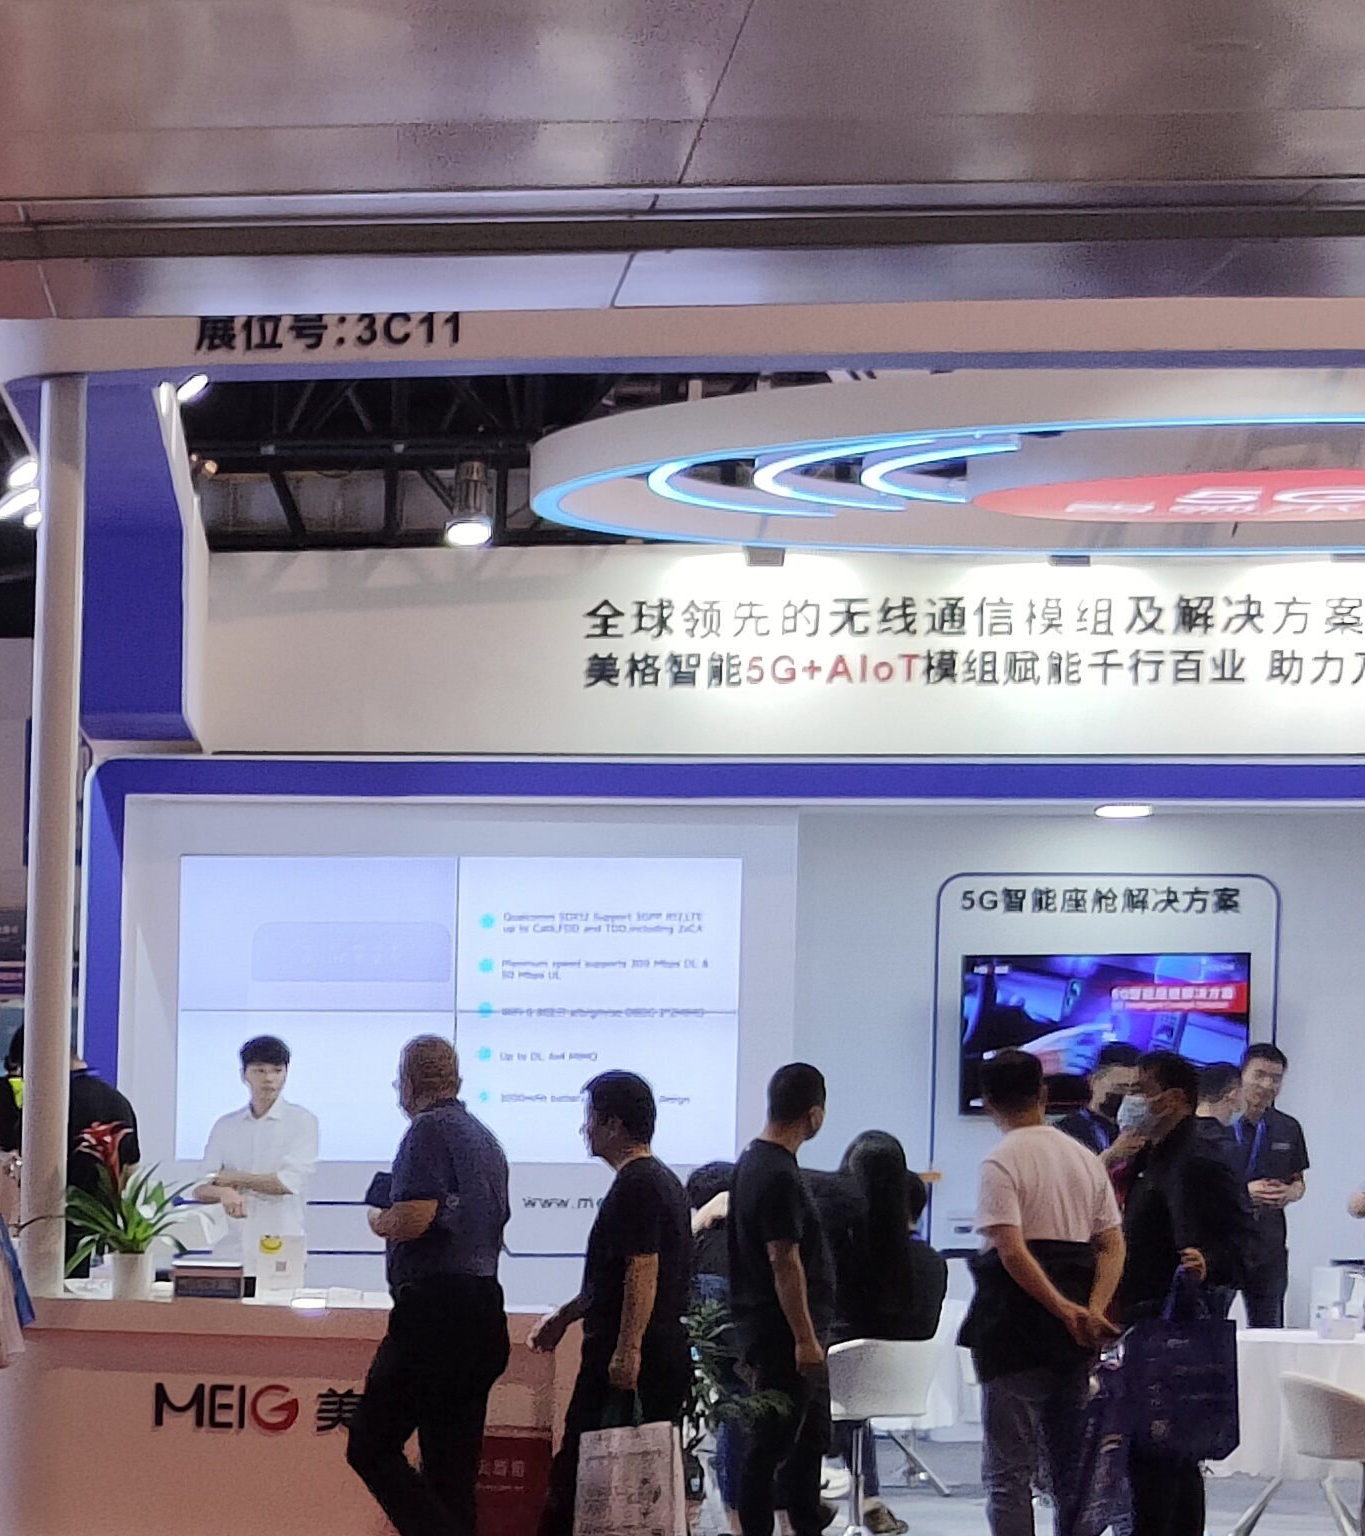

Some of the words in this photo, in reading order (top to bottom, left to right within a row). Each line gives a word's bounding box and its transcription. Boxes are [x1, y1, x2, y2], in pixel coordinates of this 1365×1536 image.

[583, 596, 1363, 639] 全球领先的无线通信模组及解决方案
[961, 886, 1243, 915] 5G智能座舱解决方案
[154, 1382, 297, 1432] MEIG
